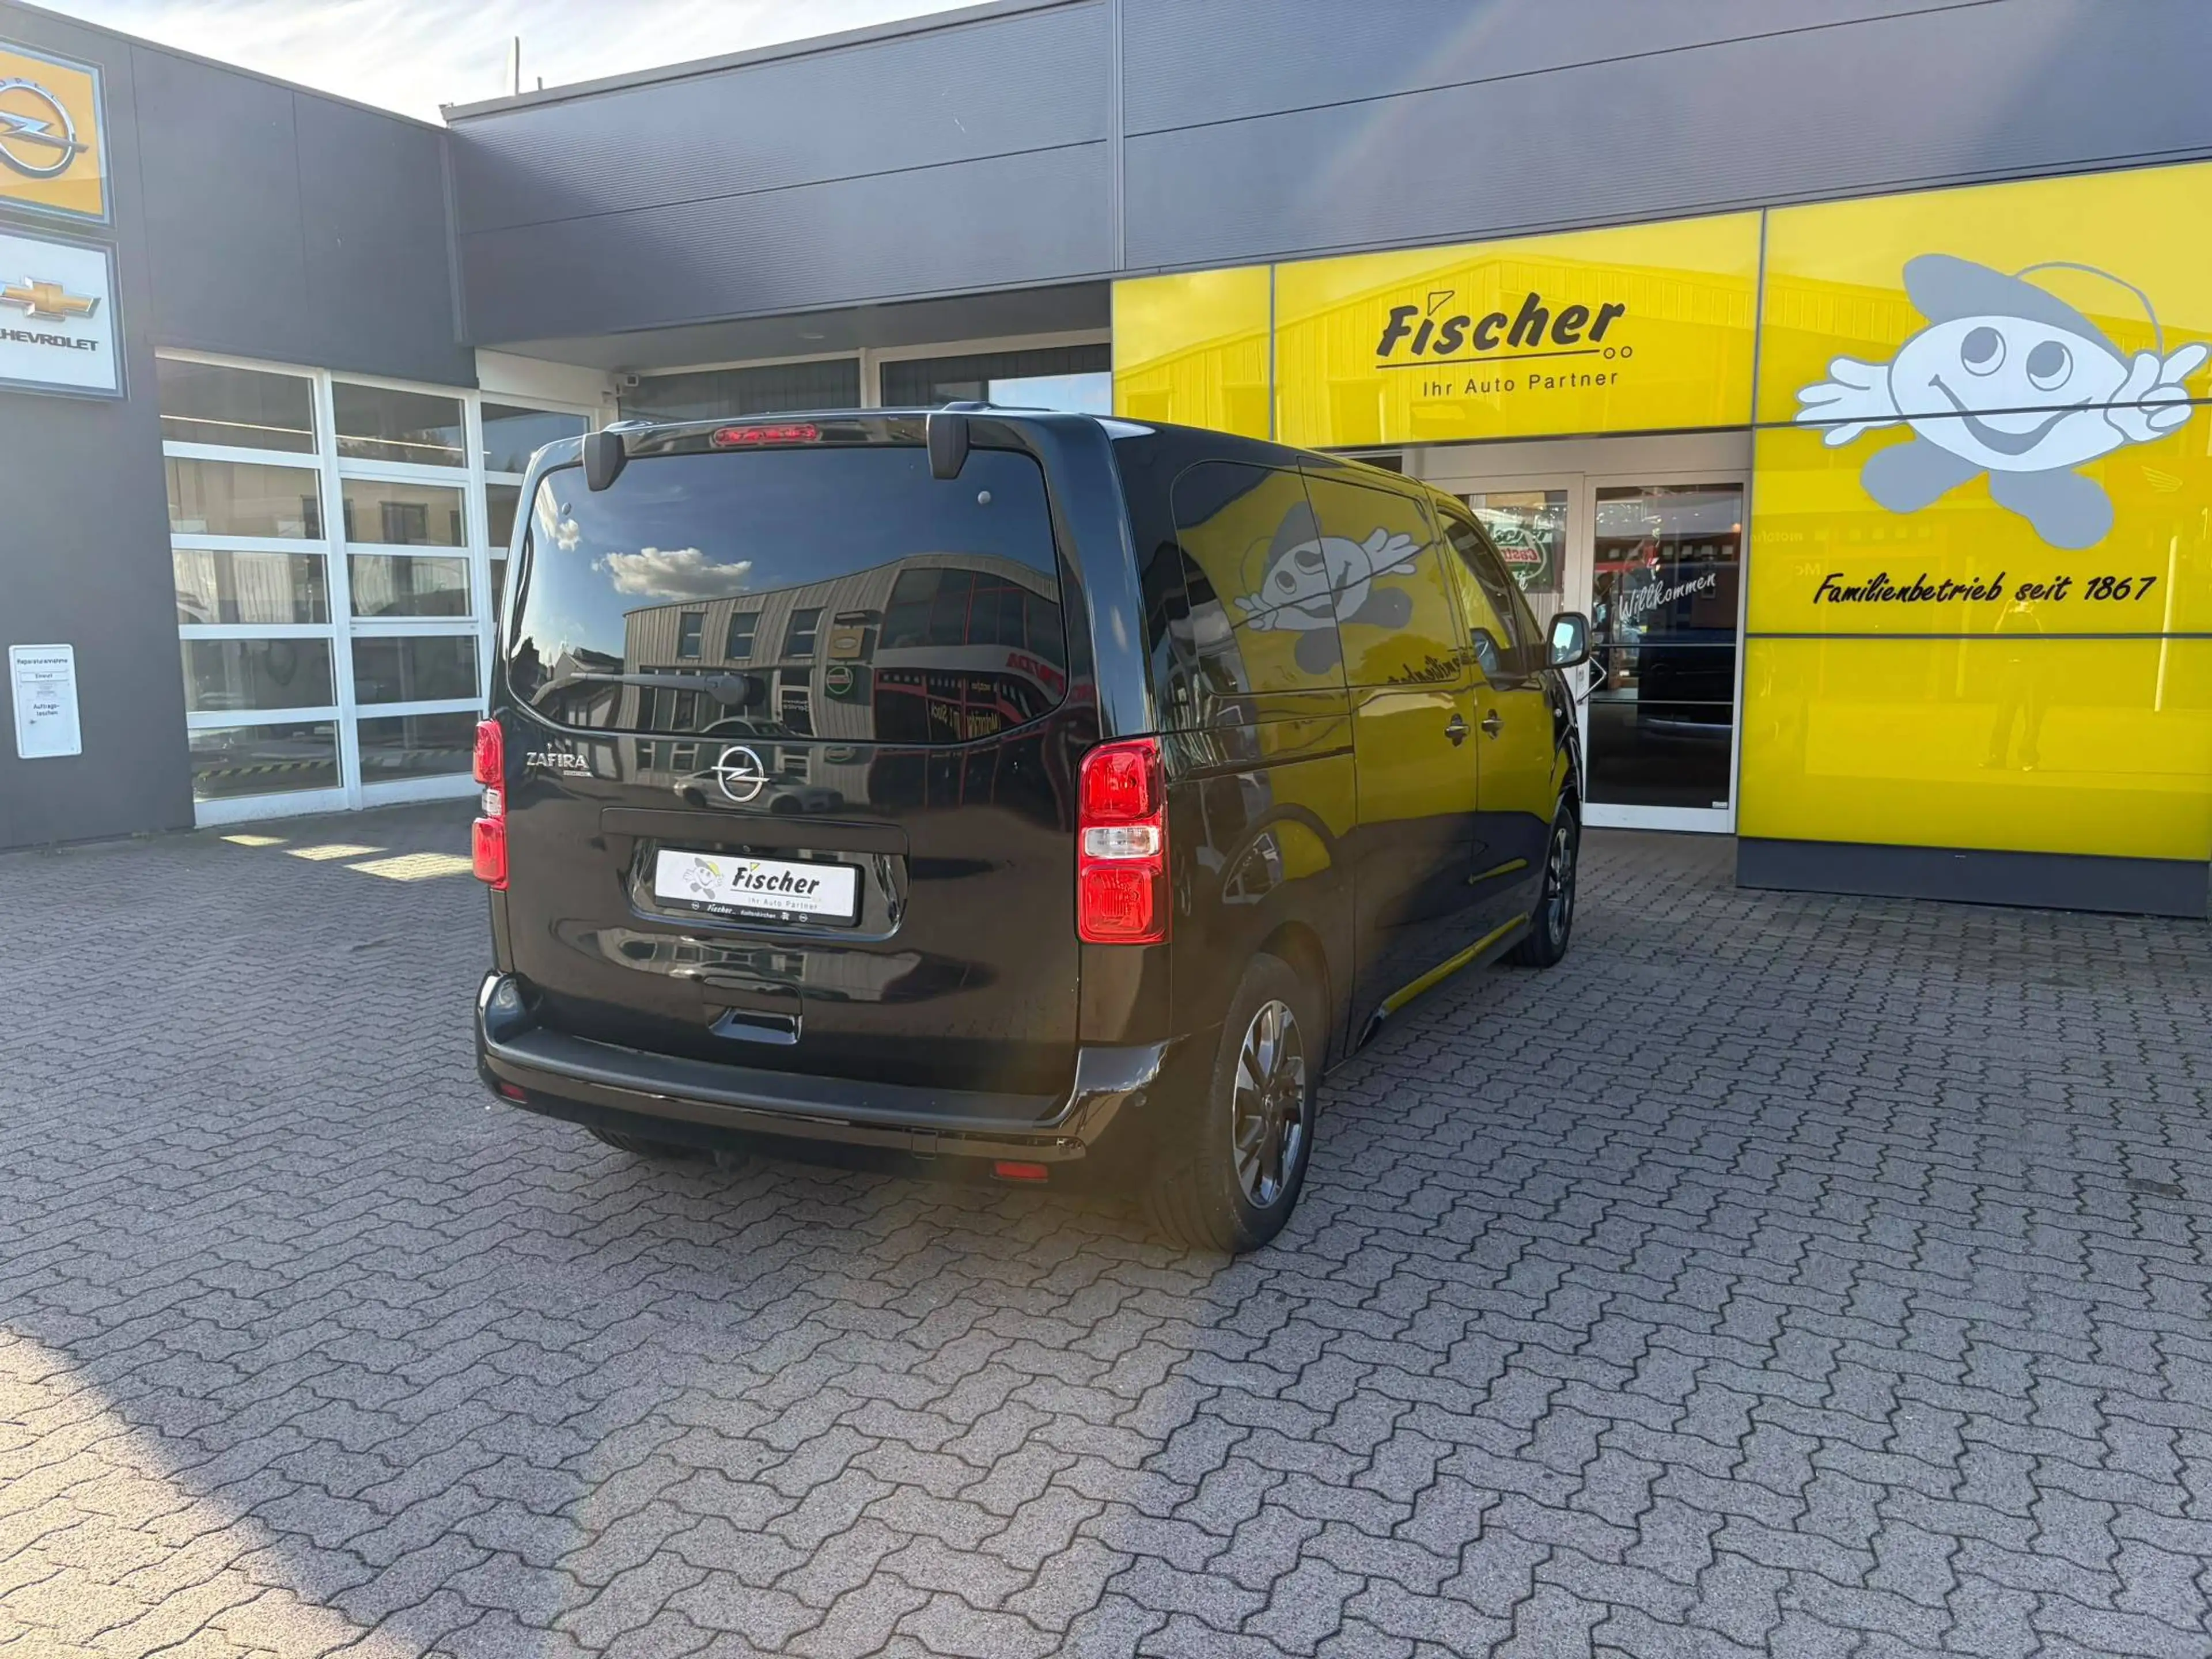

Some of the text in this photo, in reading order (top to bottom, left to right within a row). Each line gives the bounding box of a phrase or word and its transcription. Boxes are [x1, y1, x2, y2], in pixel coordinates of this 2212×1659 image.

[1376, 290, 1626, 357] Fischer
[0, 328, 99, 351] HEVROLET
[1423, 371, 1619, 397] Ihr Auto Partner
[1619, 573, 1717, 623] Willkommen
[1813, 571, 2157, 604] Familienbetrieb seit 1867
[527, 752, 590, 770] ZAFIRA
[732, 862, 820, 895] Fischer
[707, 903, 733, 914] Fischer
[748, 896, 817, 910] Ihr Auto Partner
